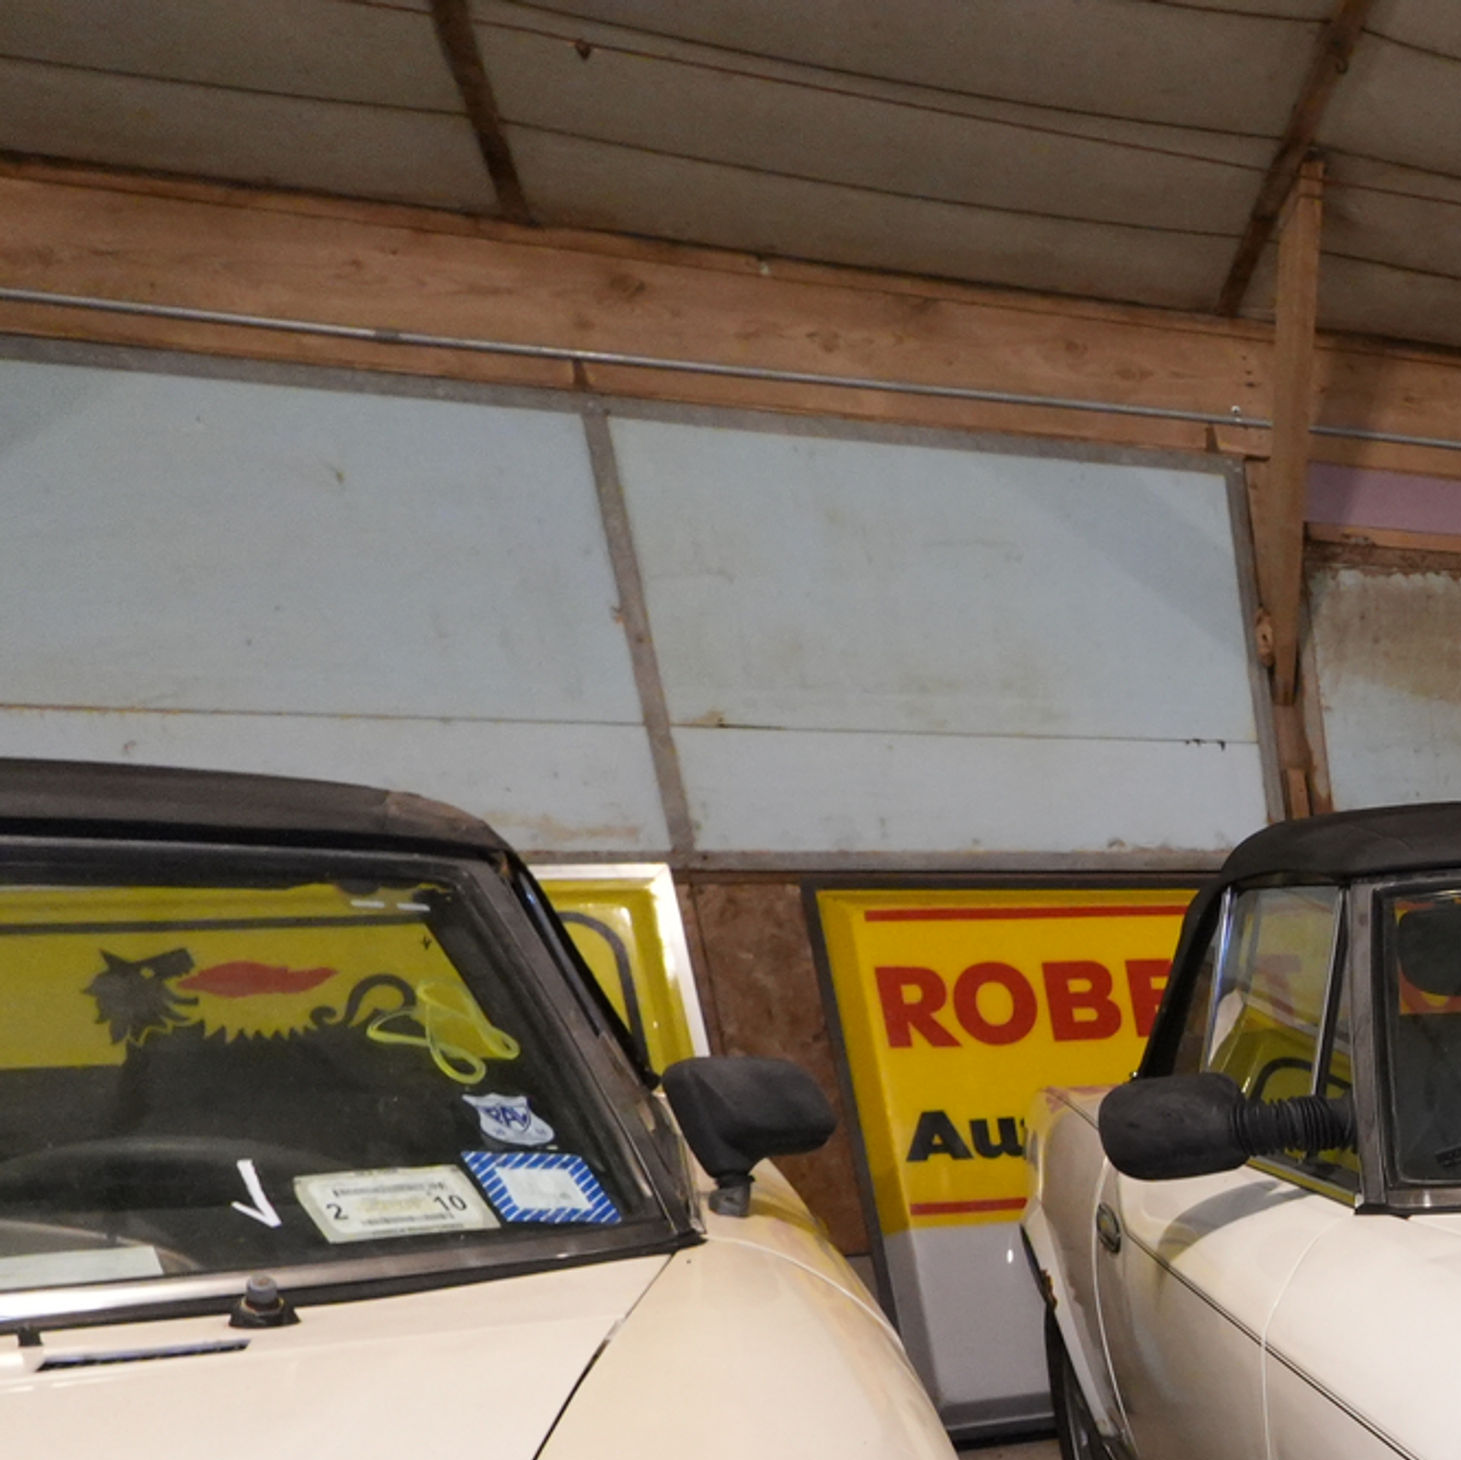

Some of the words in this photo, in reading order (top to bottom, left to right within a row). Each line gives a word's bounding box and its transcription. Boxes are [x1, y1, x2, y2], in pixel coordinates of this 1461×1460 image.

[906, 1109, 1028, 1162] Au
[326, 1202, 348, 1220] 2
[433, 1195, 467, 1212] 10
